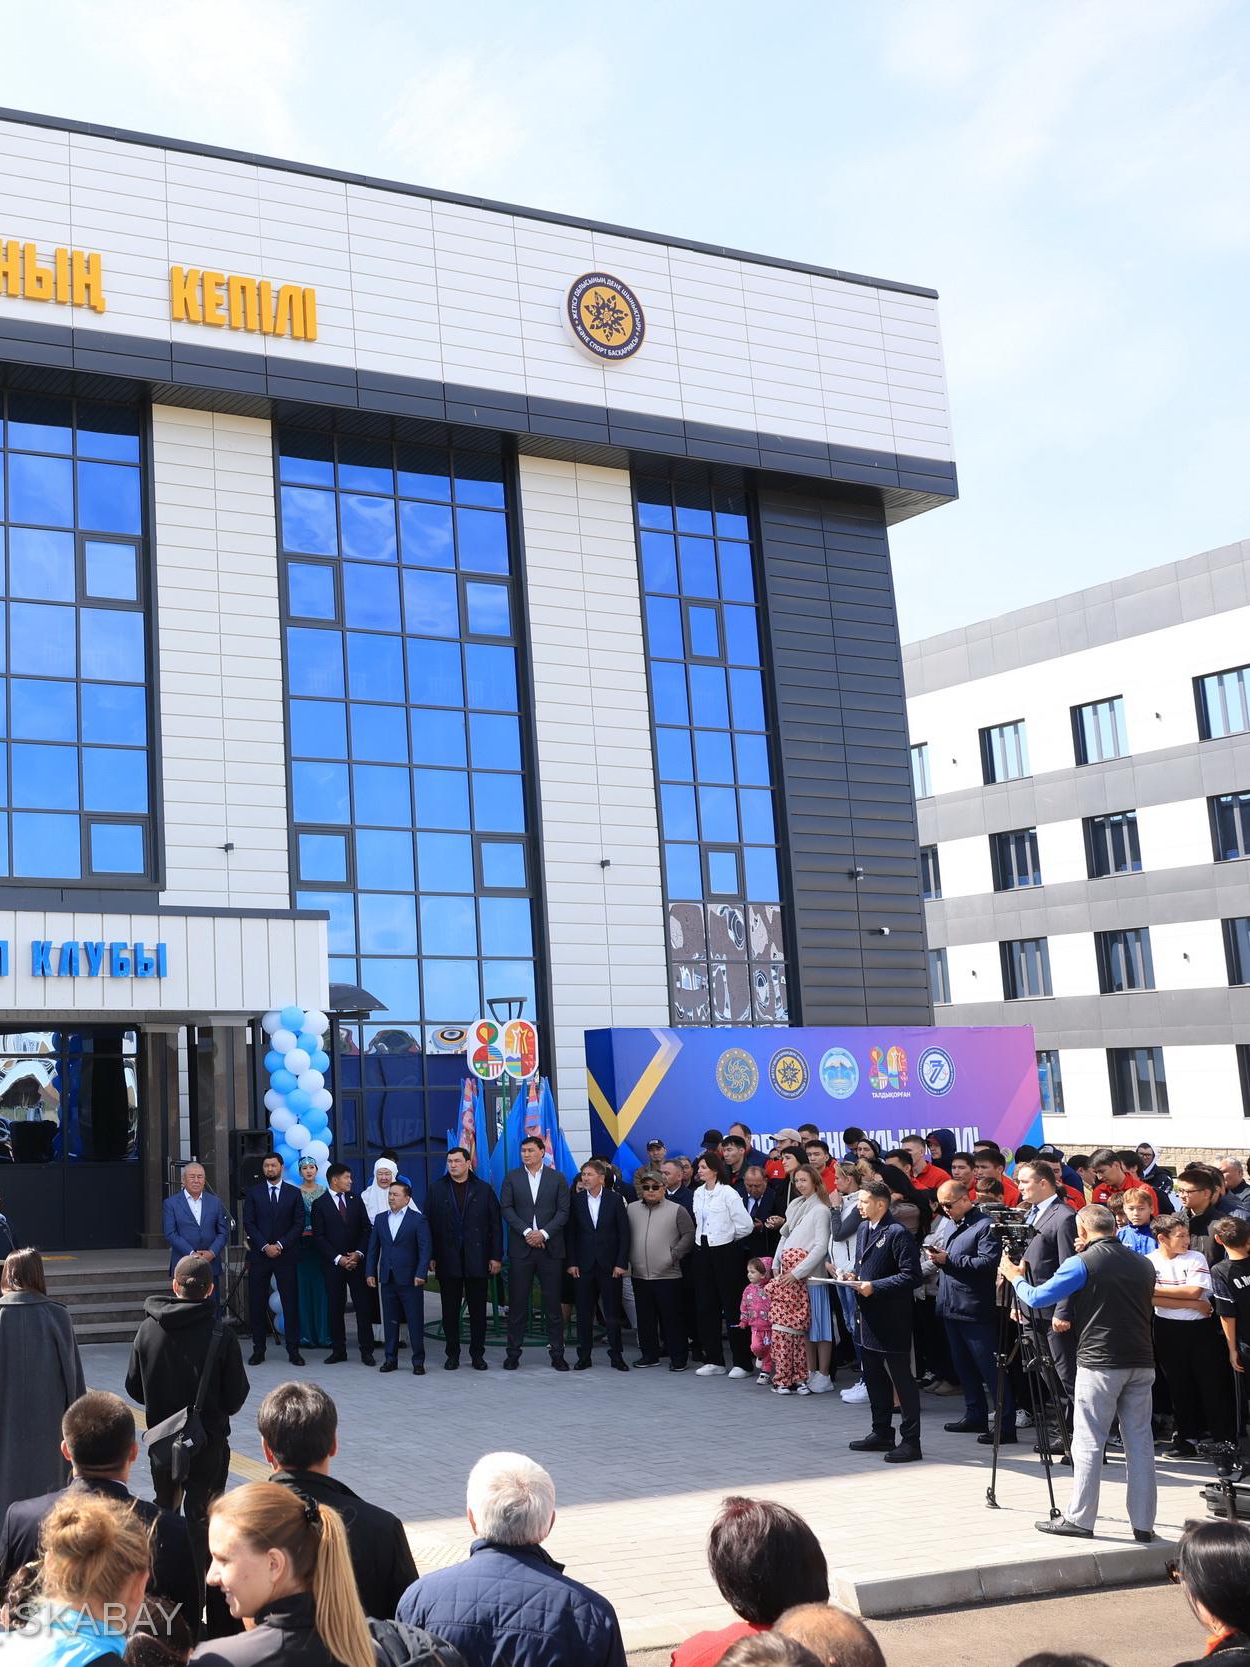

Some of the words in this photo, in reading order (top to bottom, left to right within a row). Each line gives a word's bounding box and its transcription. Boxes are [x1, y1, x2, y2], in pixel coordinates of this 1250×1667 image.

[170, 265, 318, 342] КЕПІЛІ
[589, 341, 608, 355] СПОРТ
[31, 940, 168, 978] КЛУБЫ
[871, 1091, 911, 1099] ТАЛДЫҚОРҒАН
